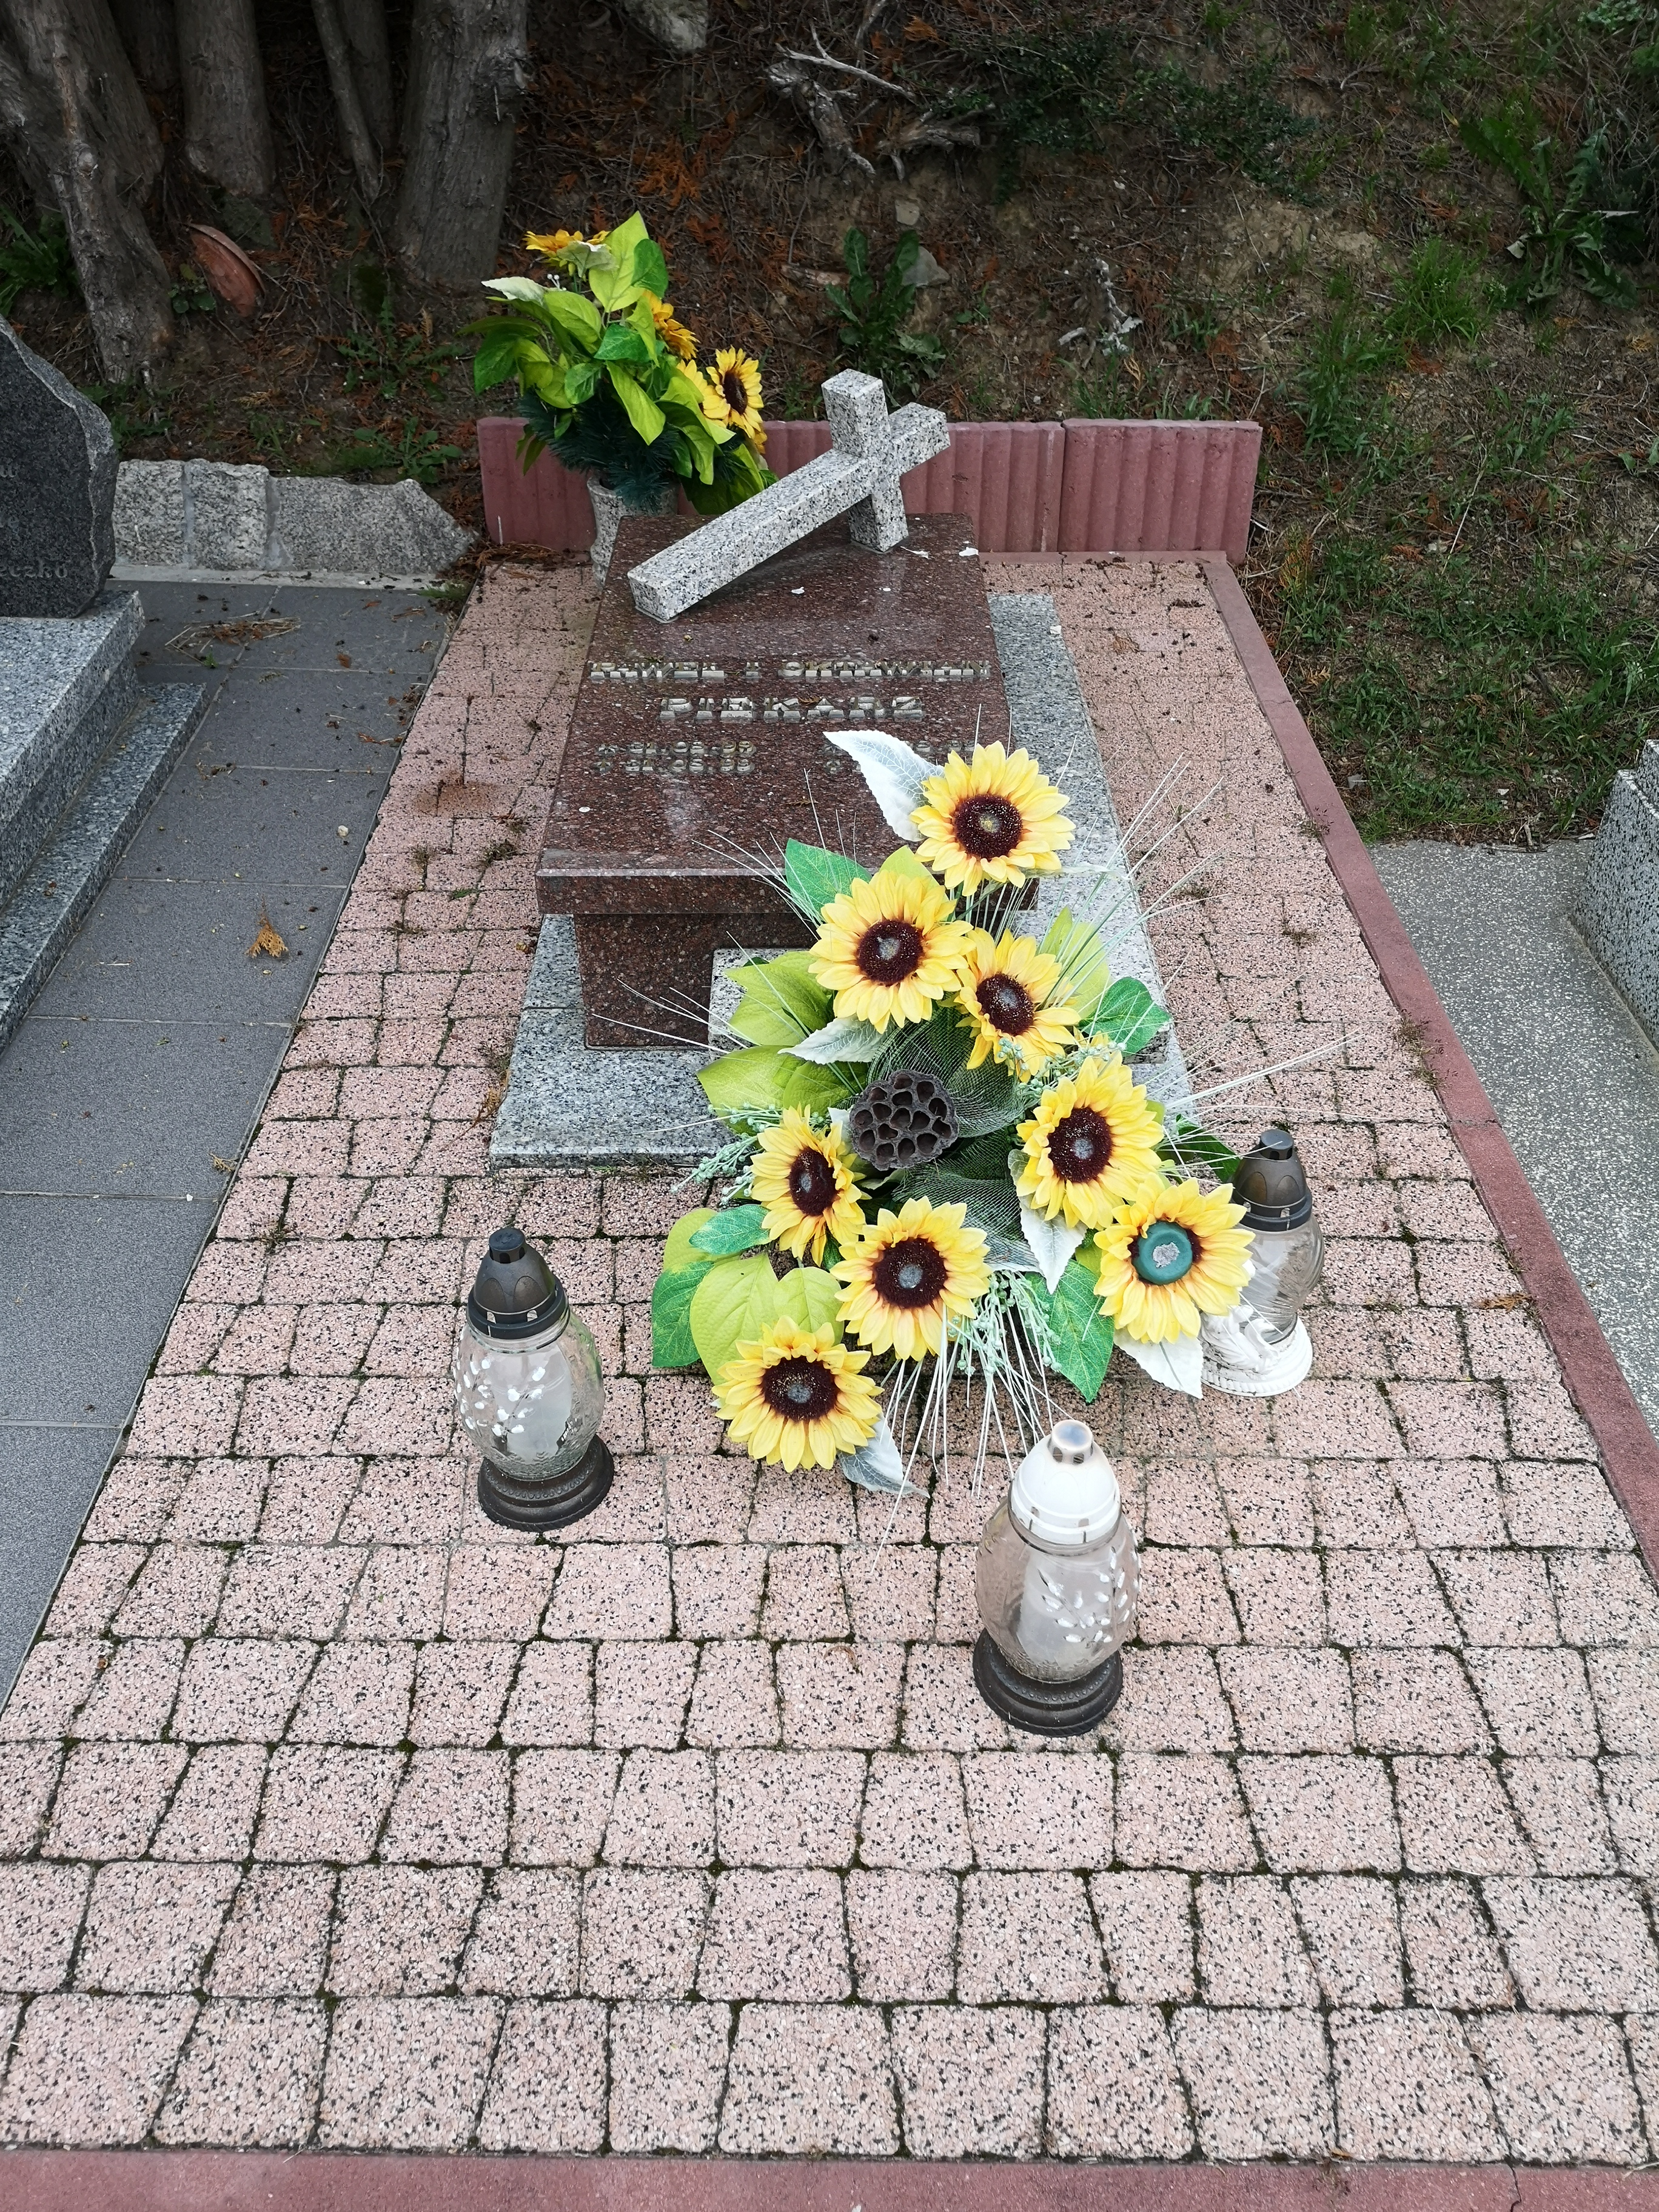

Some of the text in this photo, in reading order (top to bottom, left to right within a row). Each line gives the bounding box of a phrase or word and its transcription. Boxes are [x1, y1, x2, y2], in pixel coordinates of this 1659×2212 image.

[744, 661, 762, 679] I
[778, 660, 991, 678] OKTAWIAN
[659, 697, 925, 722] PIEKARZ
